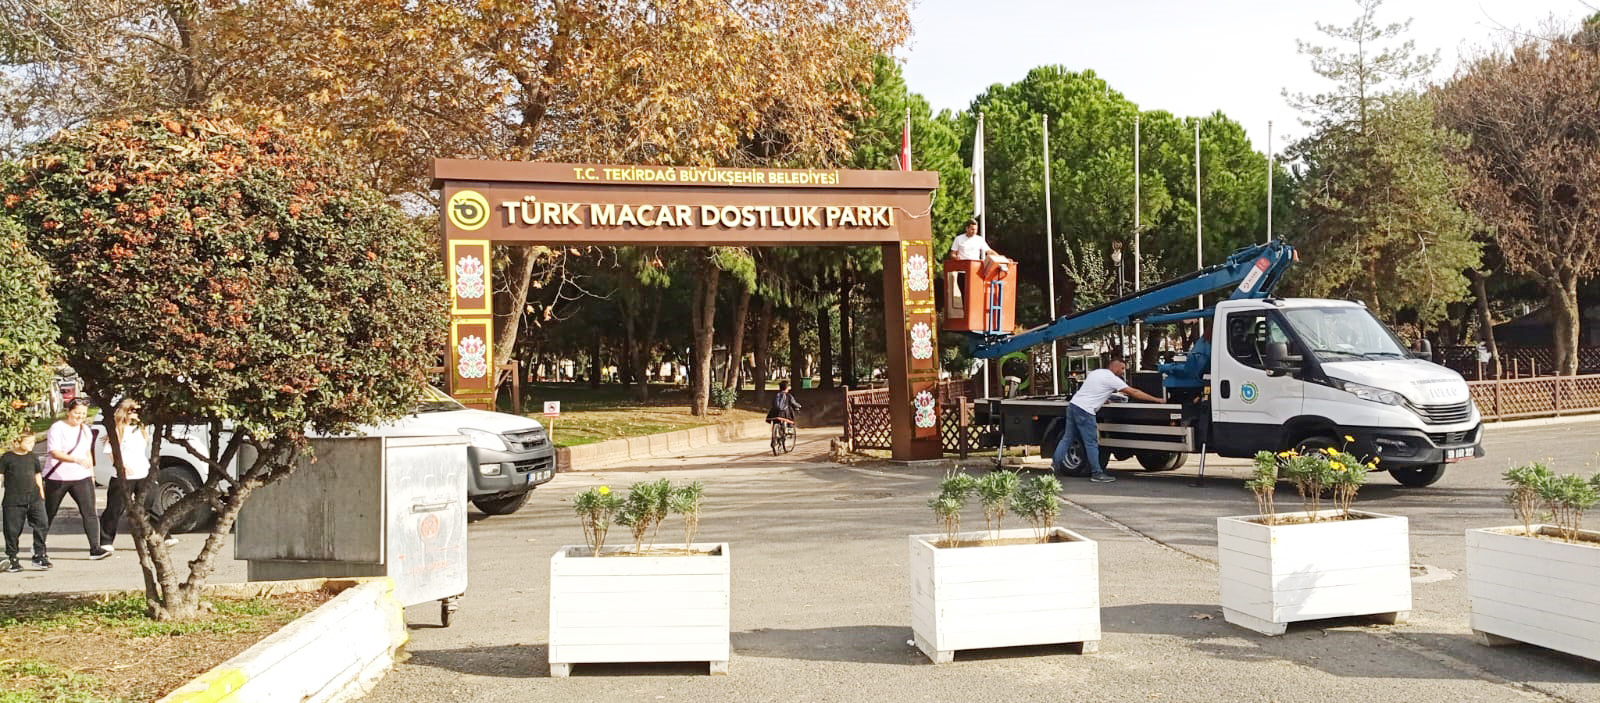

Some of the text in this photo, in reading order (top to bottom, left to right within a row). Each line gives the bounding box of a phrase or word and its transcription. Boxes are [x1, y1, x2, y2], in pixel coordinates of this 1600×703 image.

[573, 165, 840, 185] T.C. TEKİRDAĞ BÜYÜKŞEHİR BELEDİYESİ
[502, 195, 895, 228] TÜRK MACAR DOSTLUK PARKI
